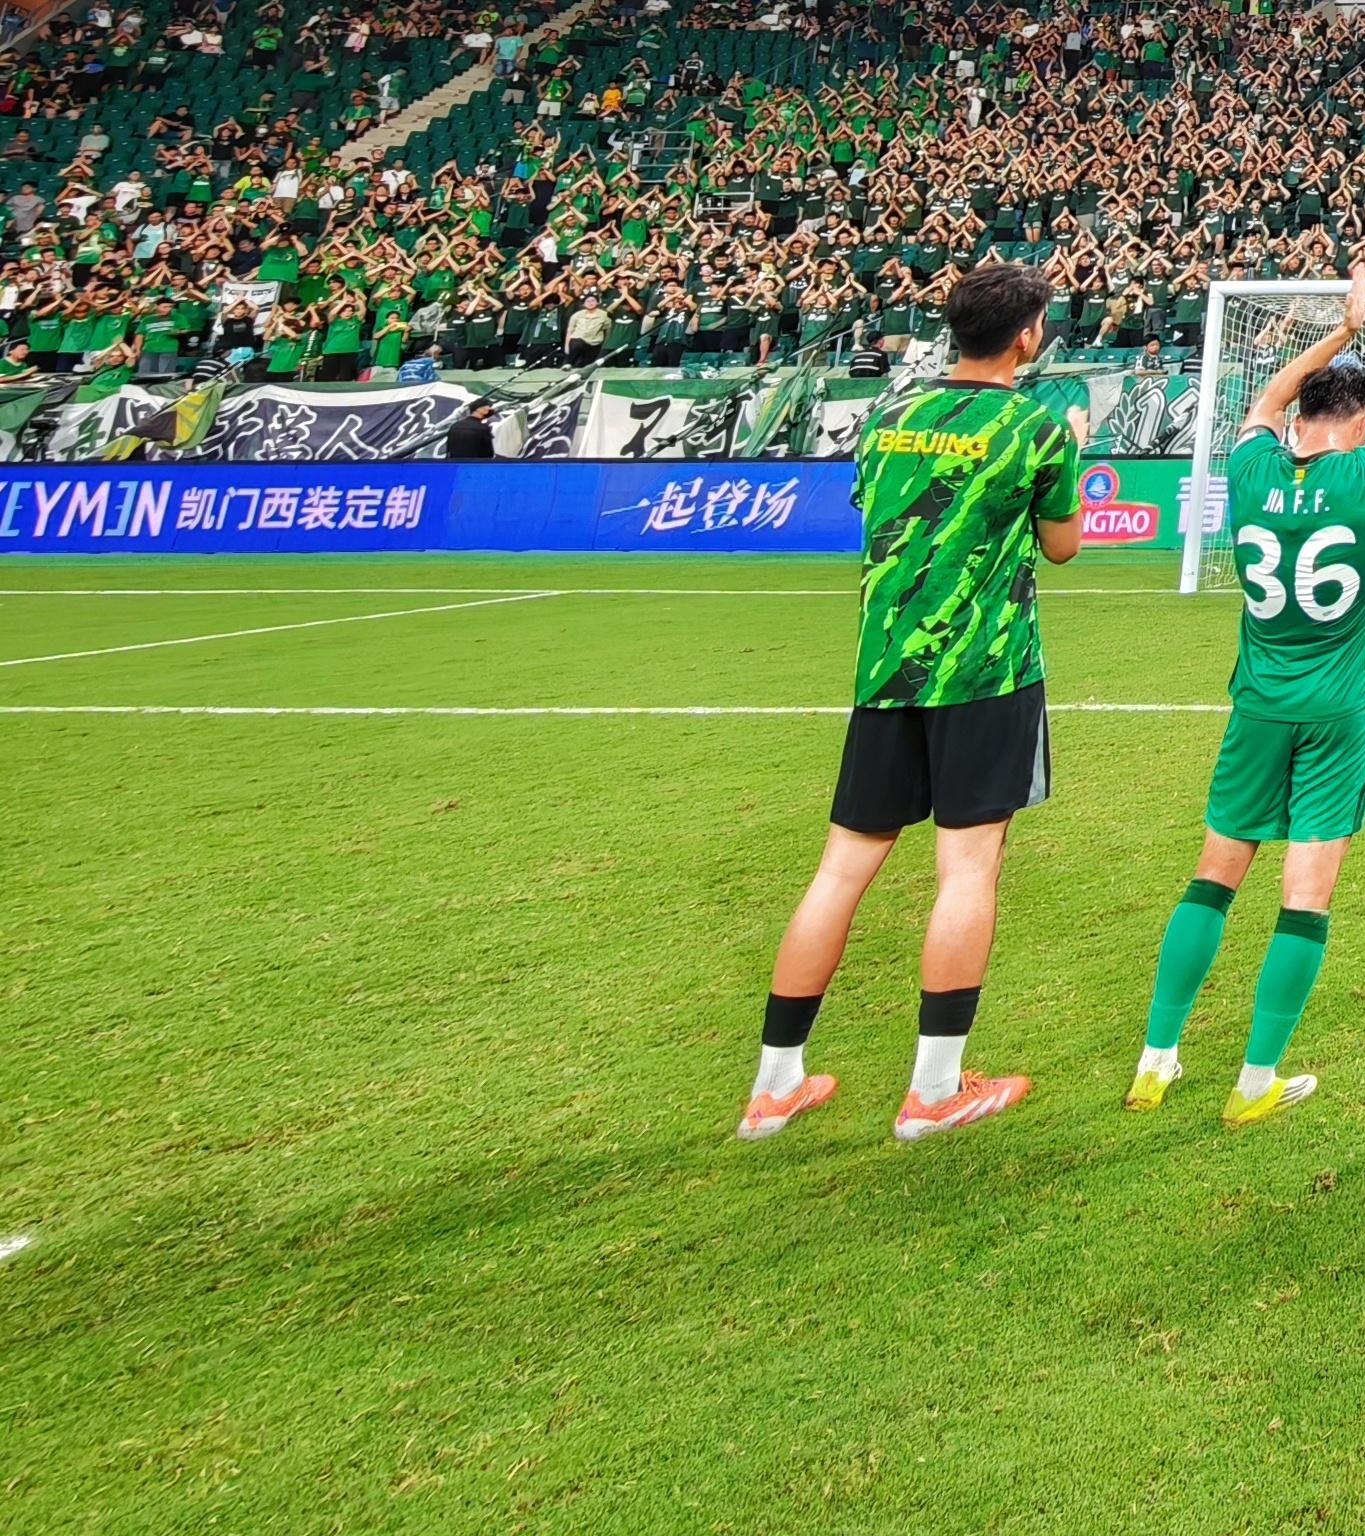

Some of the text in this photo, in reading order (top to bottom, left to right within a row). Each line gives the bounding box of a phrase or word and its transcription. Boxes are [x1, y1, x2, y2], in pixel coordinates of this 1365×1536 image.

[877, 428, 990, 458] BEIJING
[0, 480, 174, 538] EYMEN
[176, 484, 429, 531] 凯门西装定制
[601, 476, 799, 536] 一起登场
[1081, 509, 1151, 535] NGTAO
[1262, 488, 1285, 514] JIA
[1237, 524, 1361, 622] 36
